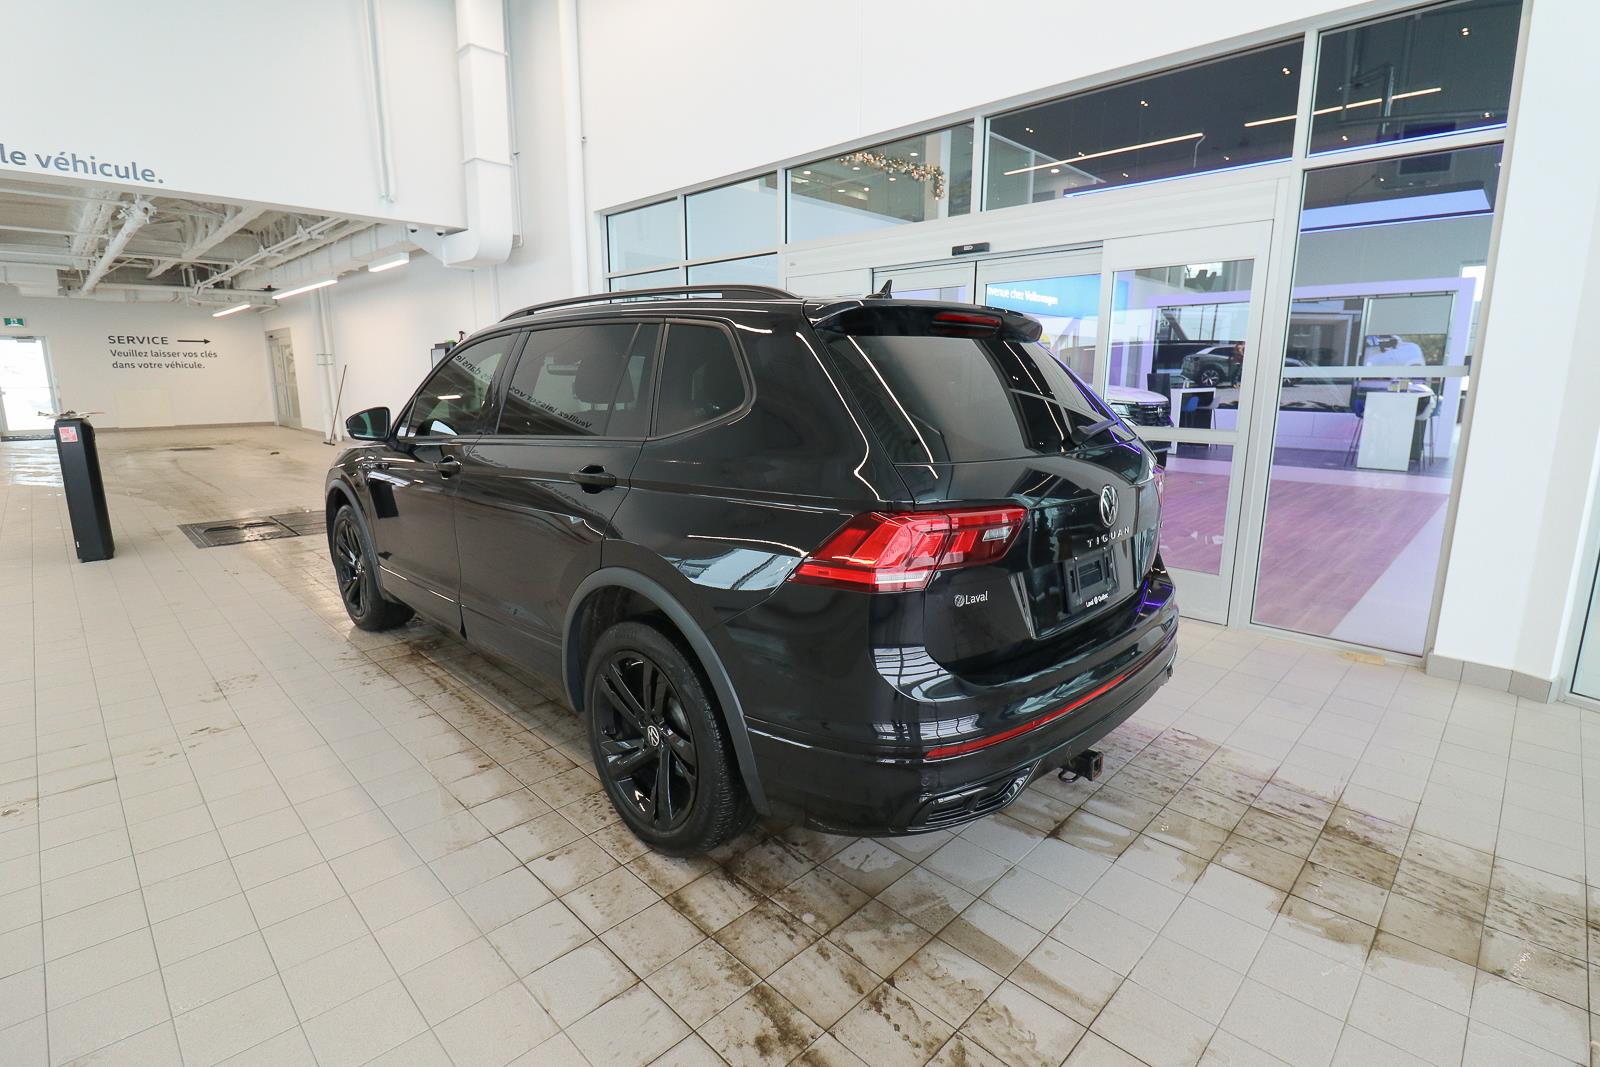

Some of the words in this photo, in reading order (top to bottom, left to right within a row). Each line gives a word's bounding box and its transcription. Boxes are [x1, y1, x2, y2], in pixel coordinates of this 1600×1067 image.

[0, 143, 27, 166] le
[34, 151, 164, 184] véhicule.
[108, 335, 169, 345] SERVICE
[110, 349, 148, 358] Veuillez
[150, 350, 180, 358] laisser
[200, 349, 218, 358] clés
[112, 361, 136, 369] dans
[164, 361, 206, 369] véhicule.
[1087, 526, 1130, 548] TIGUAN
[965, 590, 988, 605] Laval
